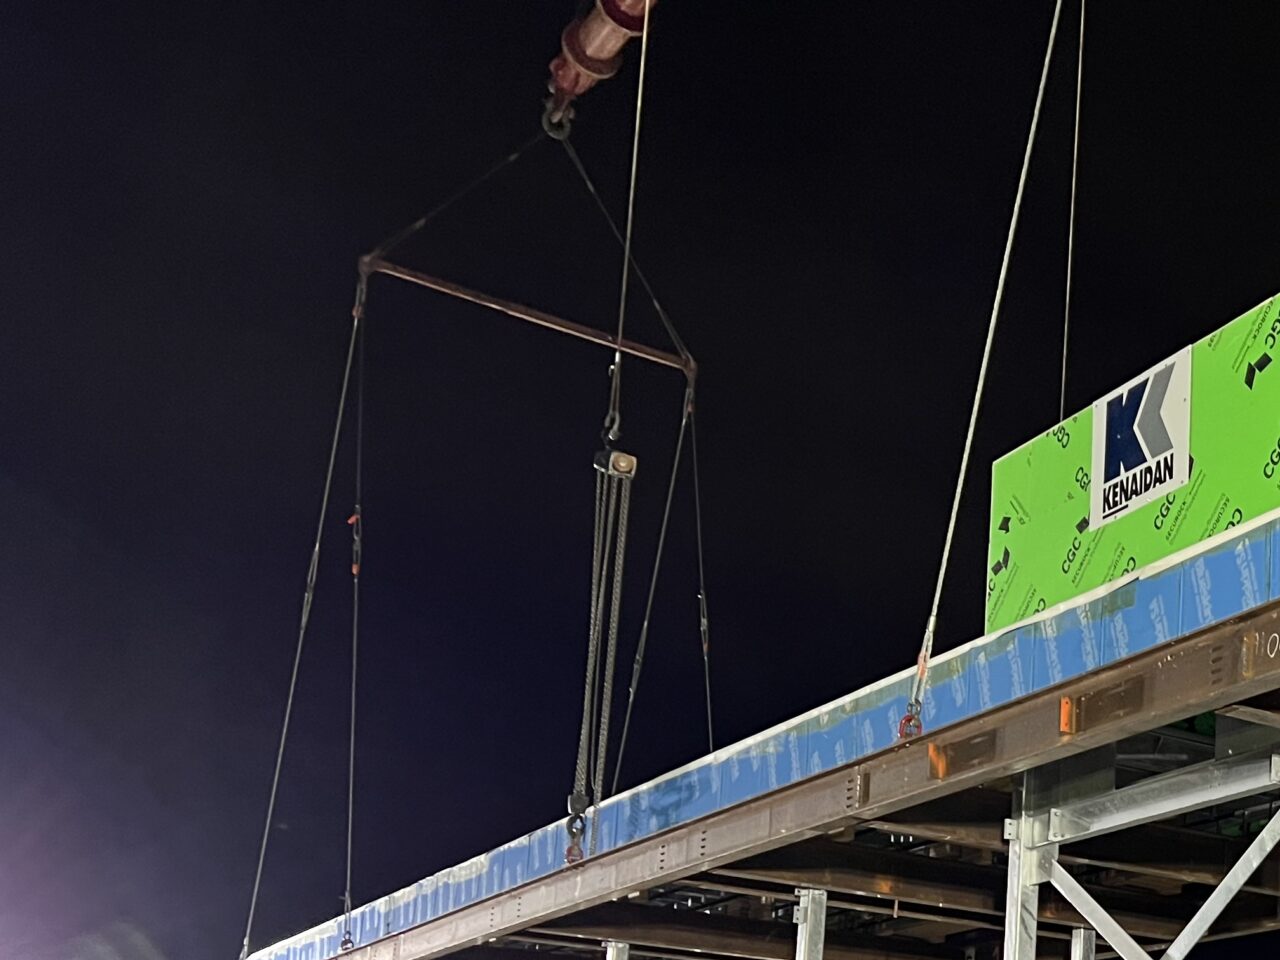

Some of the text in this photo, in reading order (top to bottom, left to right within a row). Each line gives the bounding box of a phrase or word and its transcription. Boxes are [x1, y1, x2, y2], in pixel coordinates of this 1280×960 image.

[1102, 453, 1174, 514] KENAIDAN
[1153, 492, 1176, 530] CGC
[1061, 536, 1081, 574] CGC
